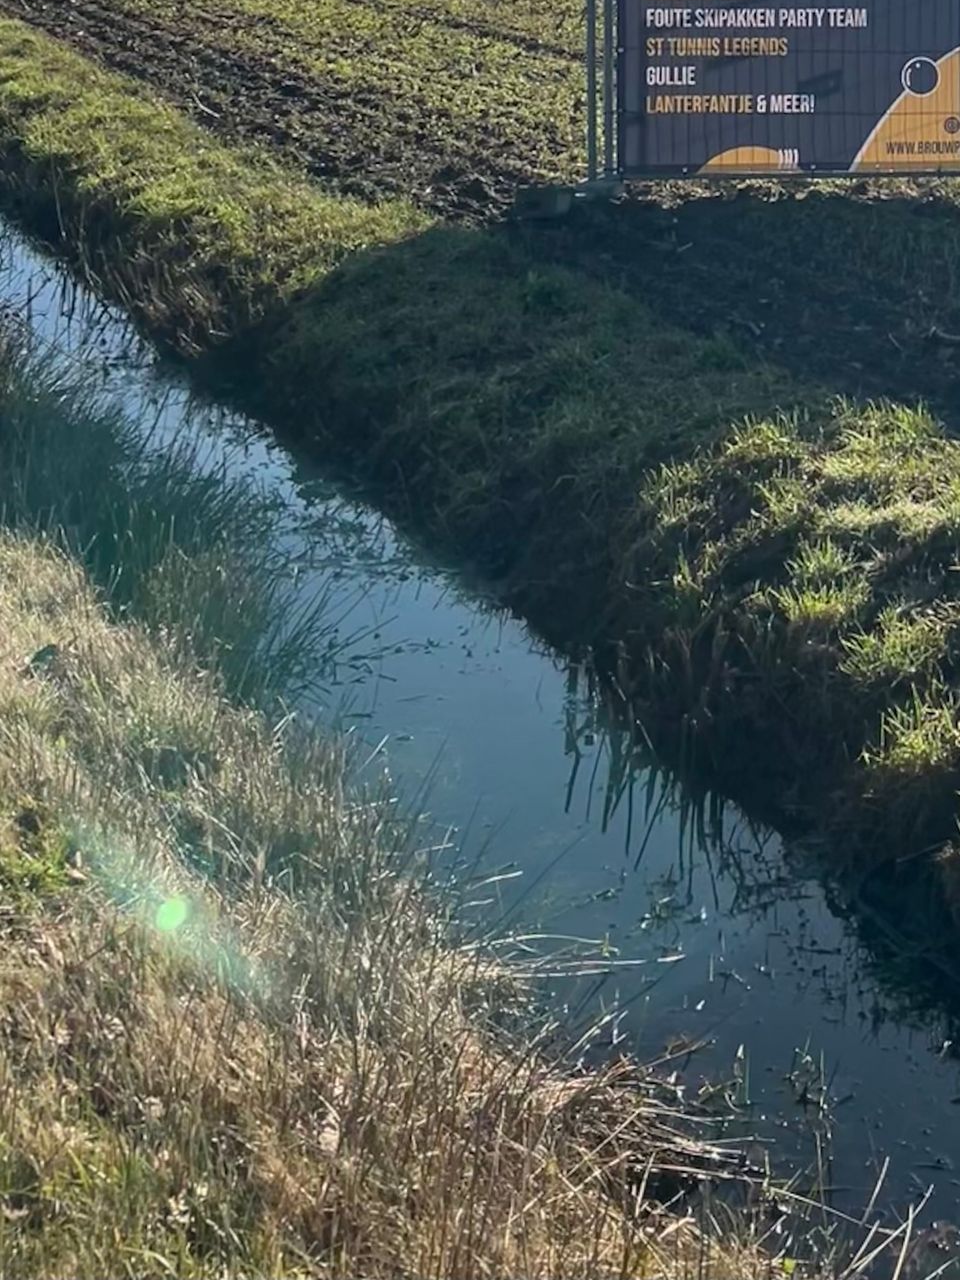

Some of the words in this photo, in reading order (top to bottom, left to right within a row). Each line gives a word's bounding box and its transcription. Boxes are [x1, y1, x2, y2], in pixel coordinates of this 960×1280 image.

[646, 8, 692, 28] FOUTE
[694, 8, 775, 27] SKIPAKKEN
[779, 8, 828, 27] PARTY
[827, 8, 867, 27] TEAM
[646, 37, 665, 57] ST
[668, 37, 720, 57] TUNNIS
[724, 37, 788, 56] LEGENDS
[646, 66, 696, 86] GULLIE
[646, 94, 753, 114] LANTERFANTJE
[757, 95, 767, 113] &
[770, 94, 815, 113] MEER!
